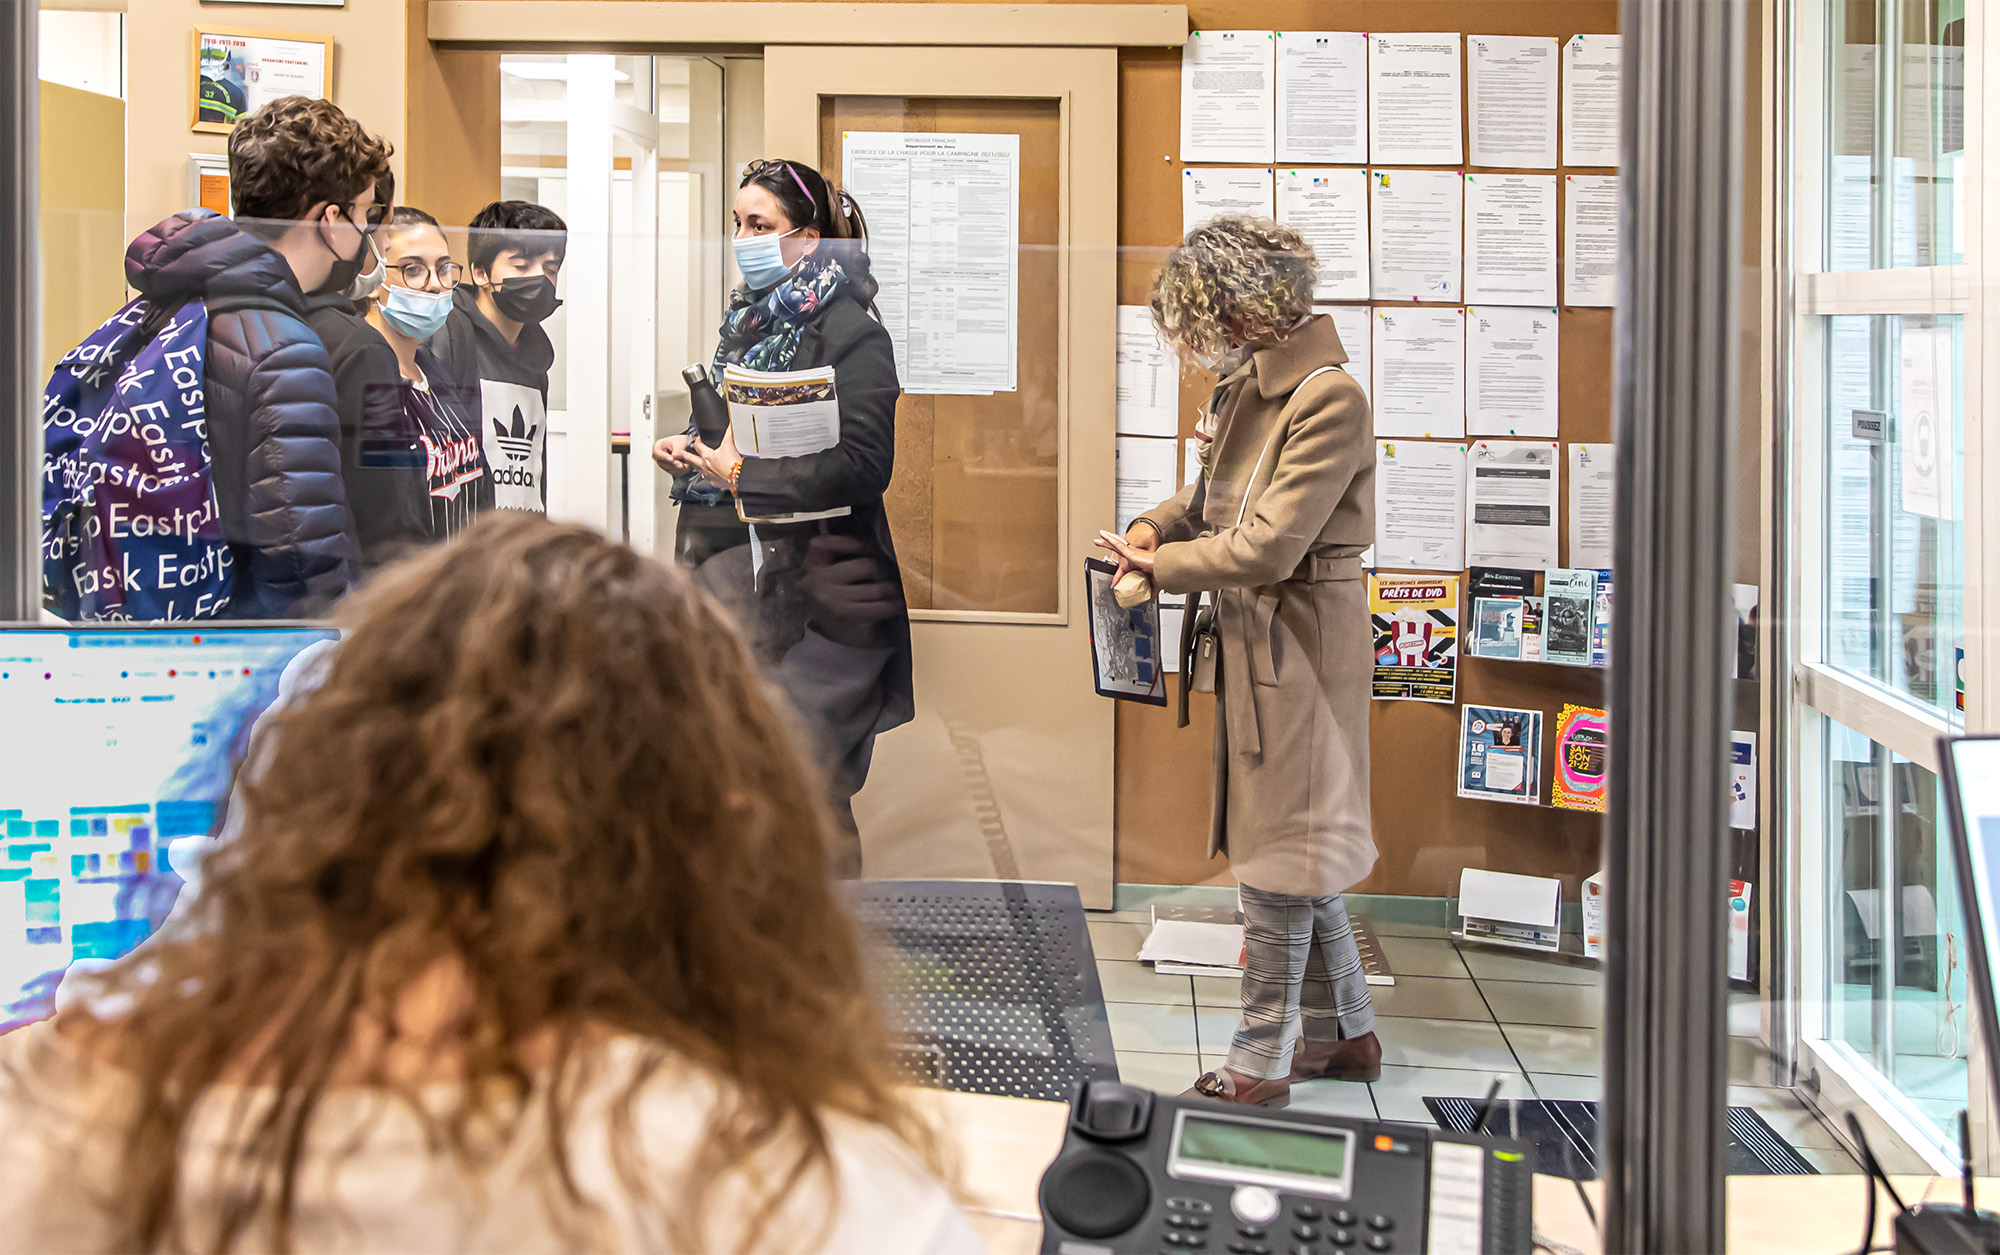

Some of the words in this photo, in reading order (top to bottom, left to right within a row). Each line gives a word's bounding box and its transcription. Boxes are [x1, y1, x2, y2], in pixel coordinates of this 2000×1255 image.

[1857, 420, 1881, 431] POUSSEZ
[493, 465, 535, 488] adida
[1381, 586, 1409, 598] PRÊTS
[1411, 588, 1424, 597] DE
[1425, 588, 1443, 597] DVD
[1569, 752, 1590, 762] SON
